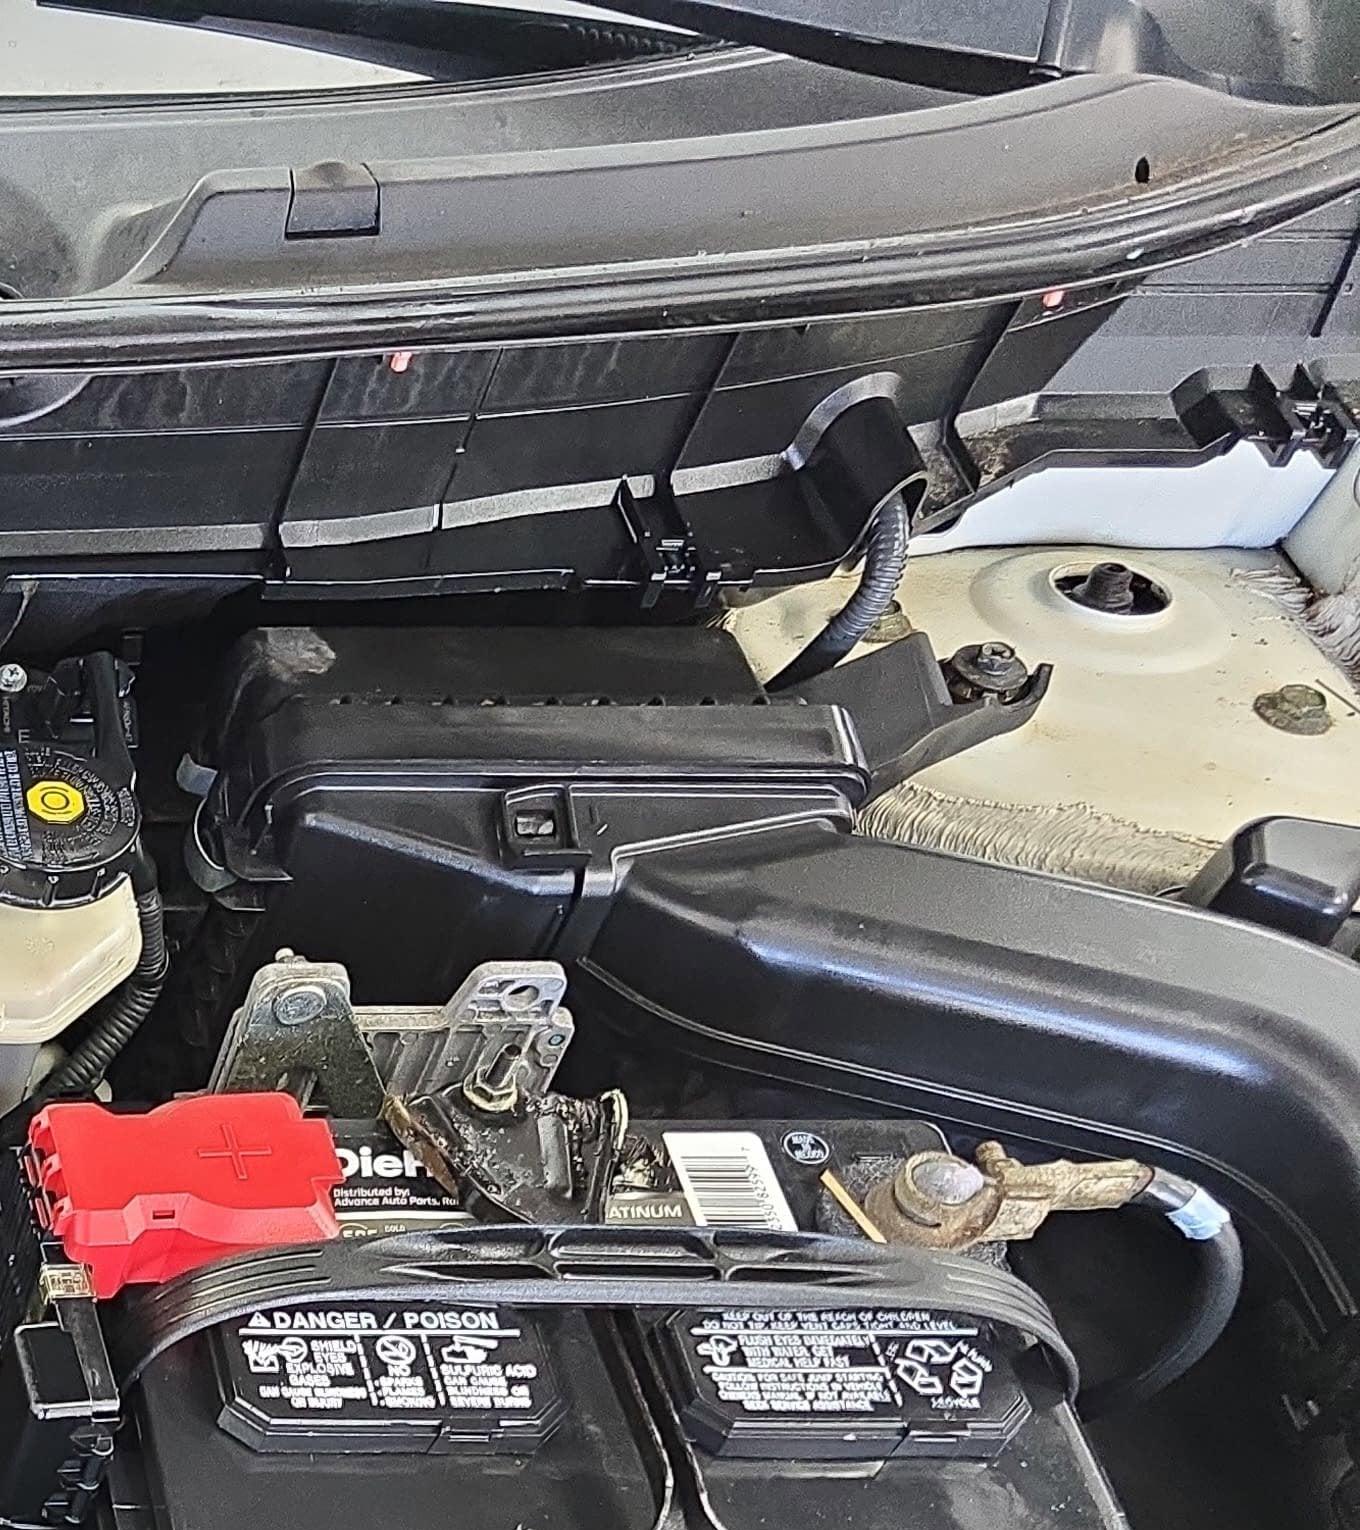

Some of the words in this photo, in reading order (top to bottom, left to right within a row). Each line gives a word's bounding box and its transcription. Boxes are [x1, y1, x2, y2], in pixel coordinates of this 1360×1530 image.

[335, 1146, 433, 1178] DieH
[333, 1187, 392, 1198] Distributed
[334, 1197, 379, 1206] Advance
[382, 1197, 407, 1206] Auto
[608, 1204, 682, 1219] ATINUM
[272, 1311, 378, 1329] DANGER
[402, 1311, 500, 1329] POISON
